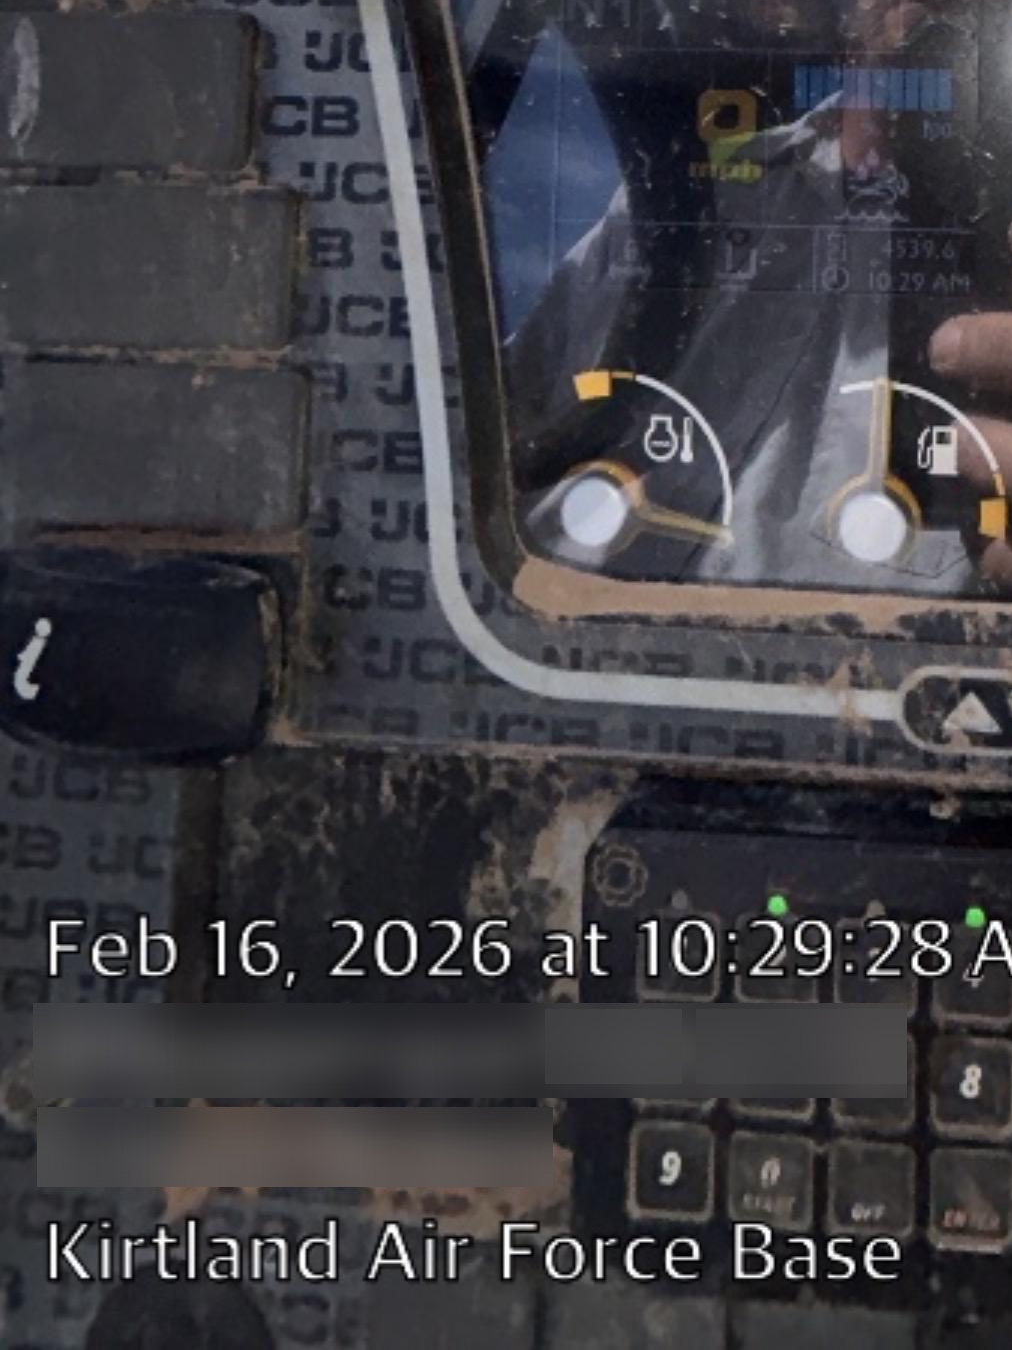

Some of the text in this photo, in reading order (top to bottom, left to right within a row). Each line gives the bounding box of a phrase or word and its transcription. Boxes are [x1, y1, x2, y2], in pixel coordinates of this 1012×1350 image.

[261, 95, 361, 139] CB
[331, 429, 423, 475] CB
[323, 564, 428, 611] CB
[959, 1063, 983, 1099] 8
[658, 1150, 682, 1187] 9
